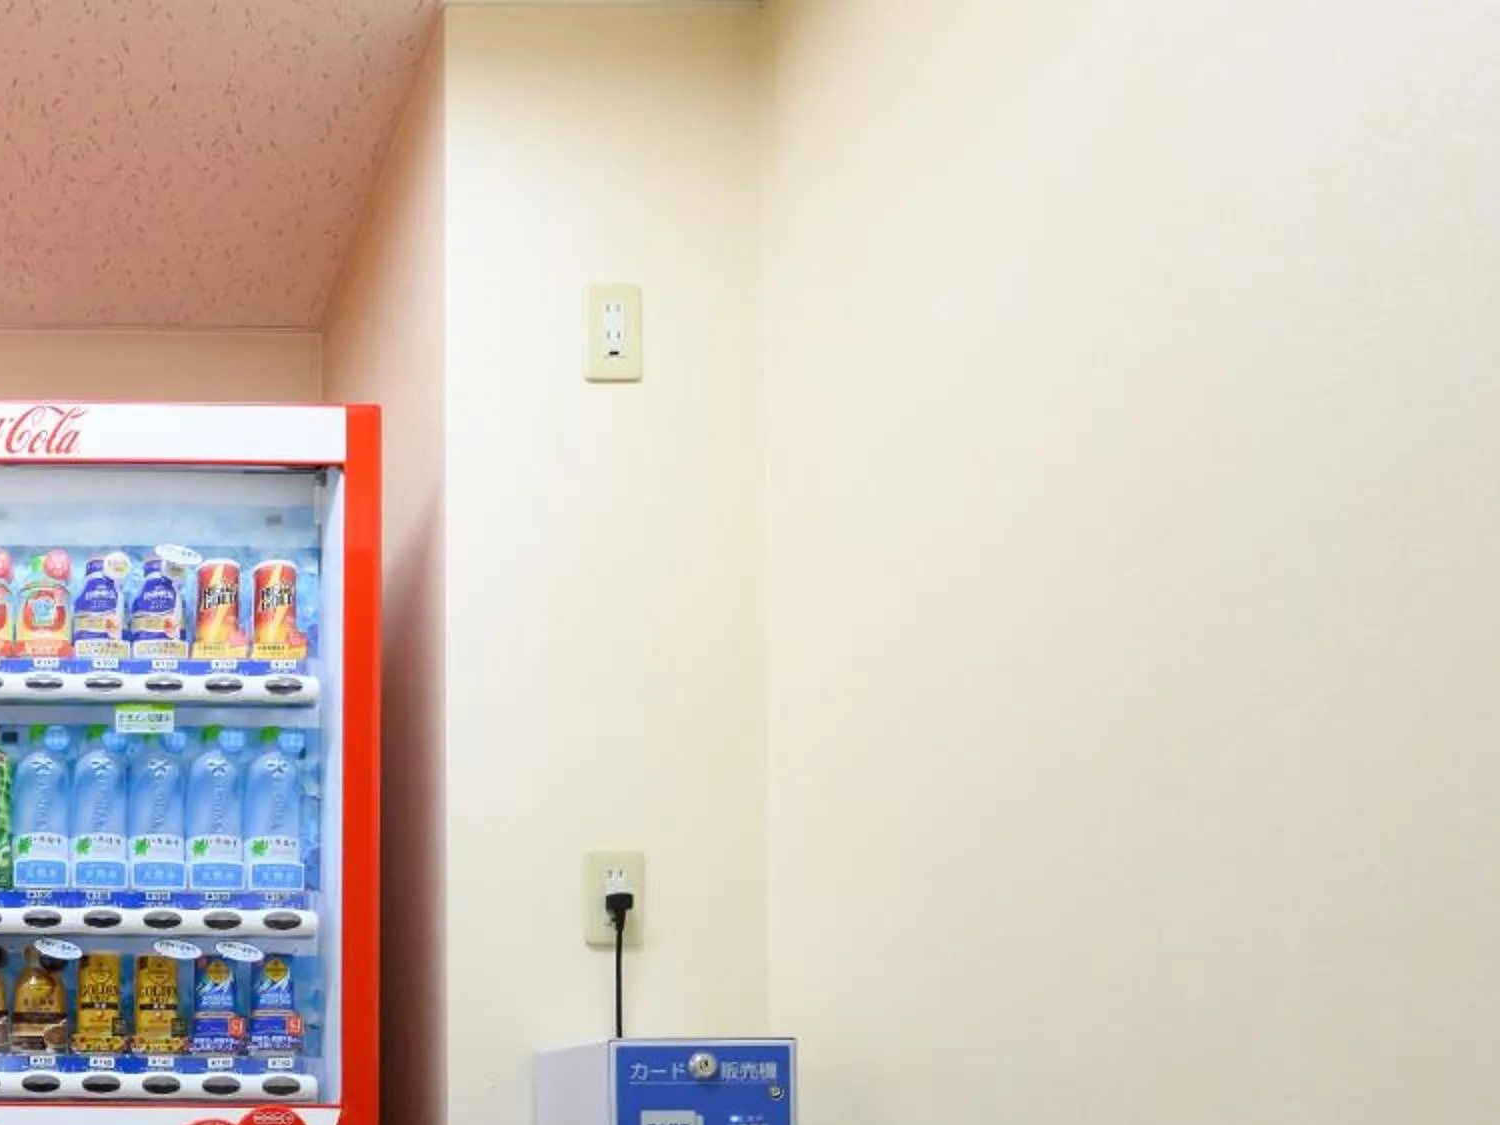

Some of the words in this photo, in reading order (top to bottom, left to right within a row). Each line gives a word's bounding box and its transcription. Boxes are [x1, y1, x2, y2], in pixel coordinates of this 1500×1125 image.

[630, 1062, 686, 1080] カード
[720, 1062, 777, 1081] 販売機
